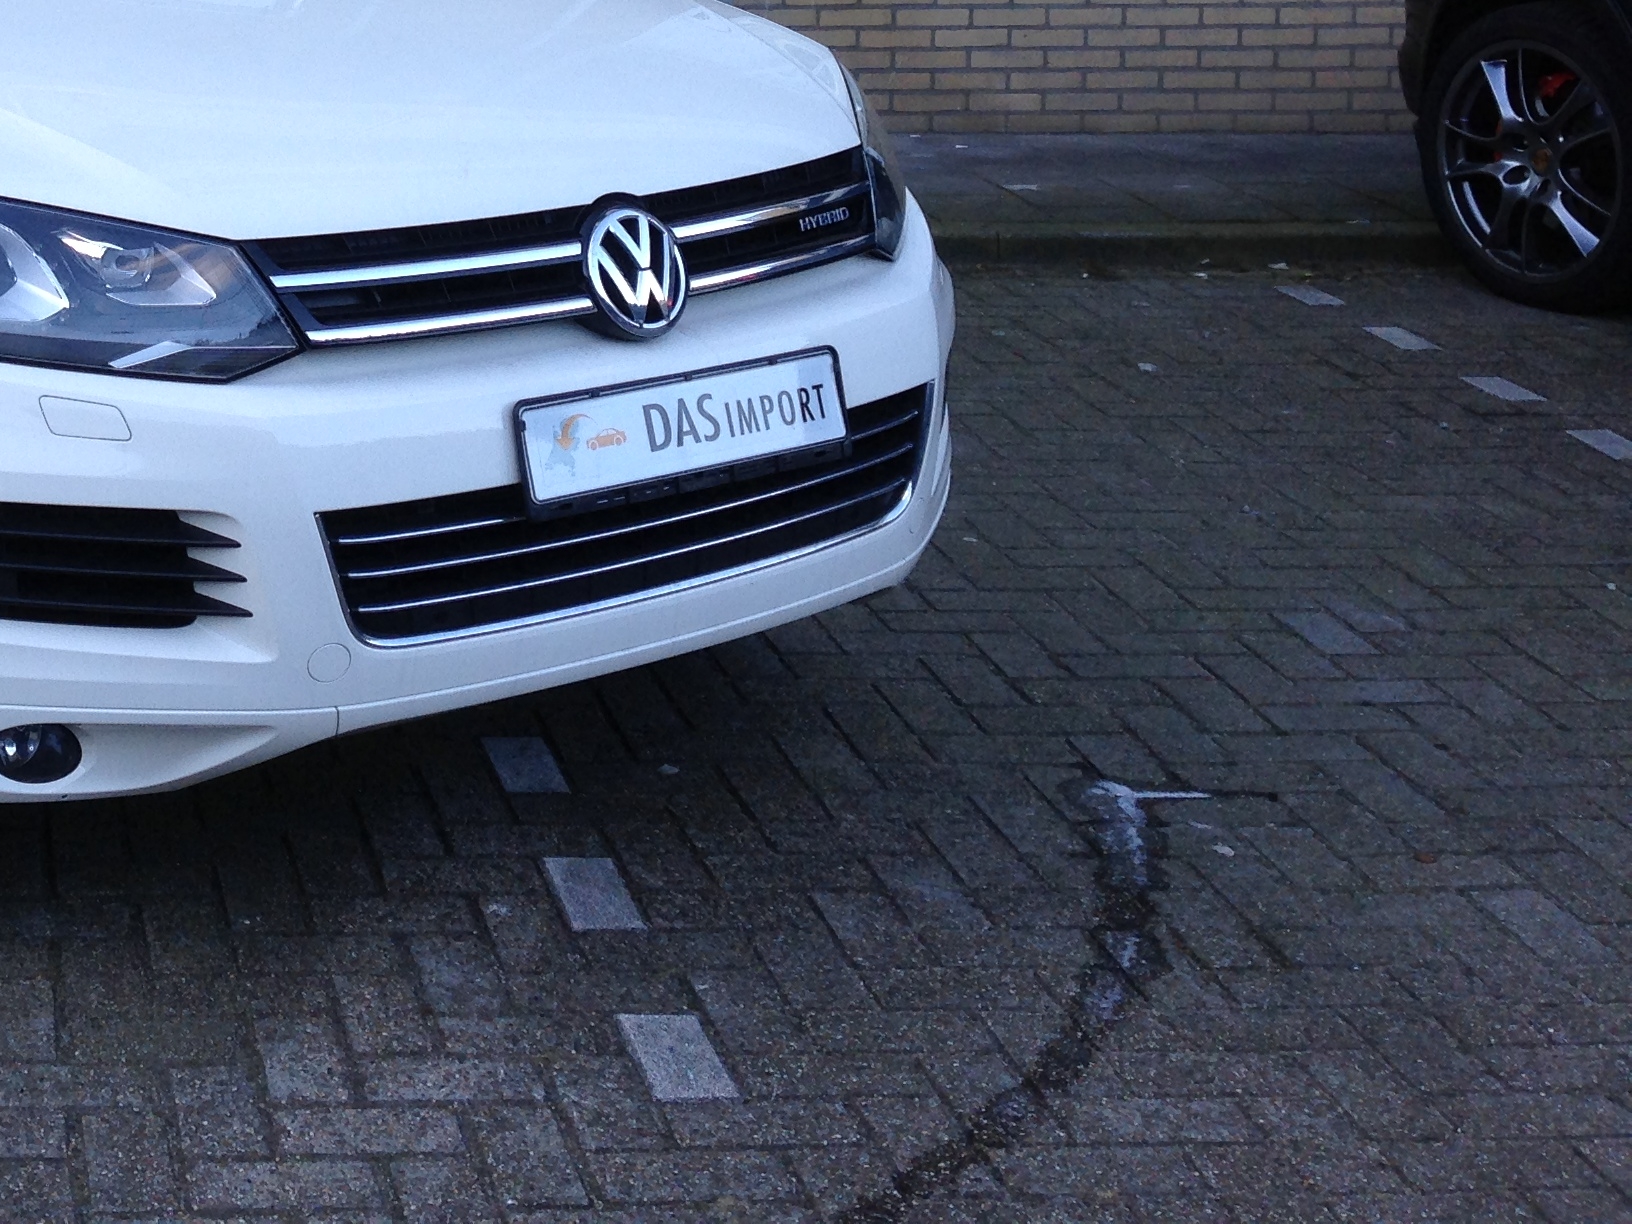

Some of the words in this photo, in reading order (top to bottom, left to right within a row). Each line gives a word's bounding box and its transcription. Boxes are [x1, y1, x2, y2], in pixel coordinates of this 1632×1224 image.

[799, 206, 849, 232] HYBRID
[642, 393, 722, 453] DAS
[724, 383, 827, 438] IMPORT
